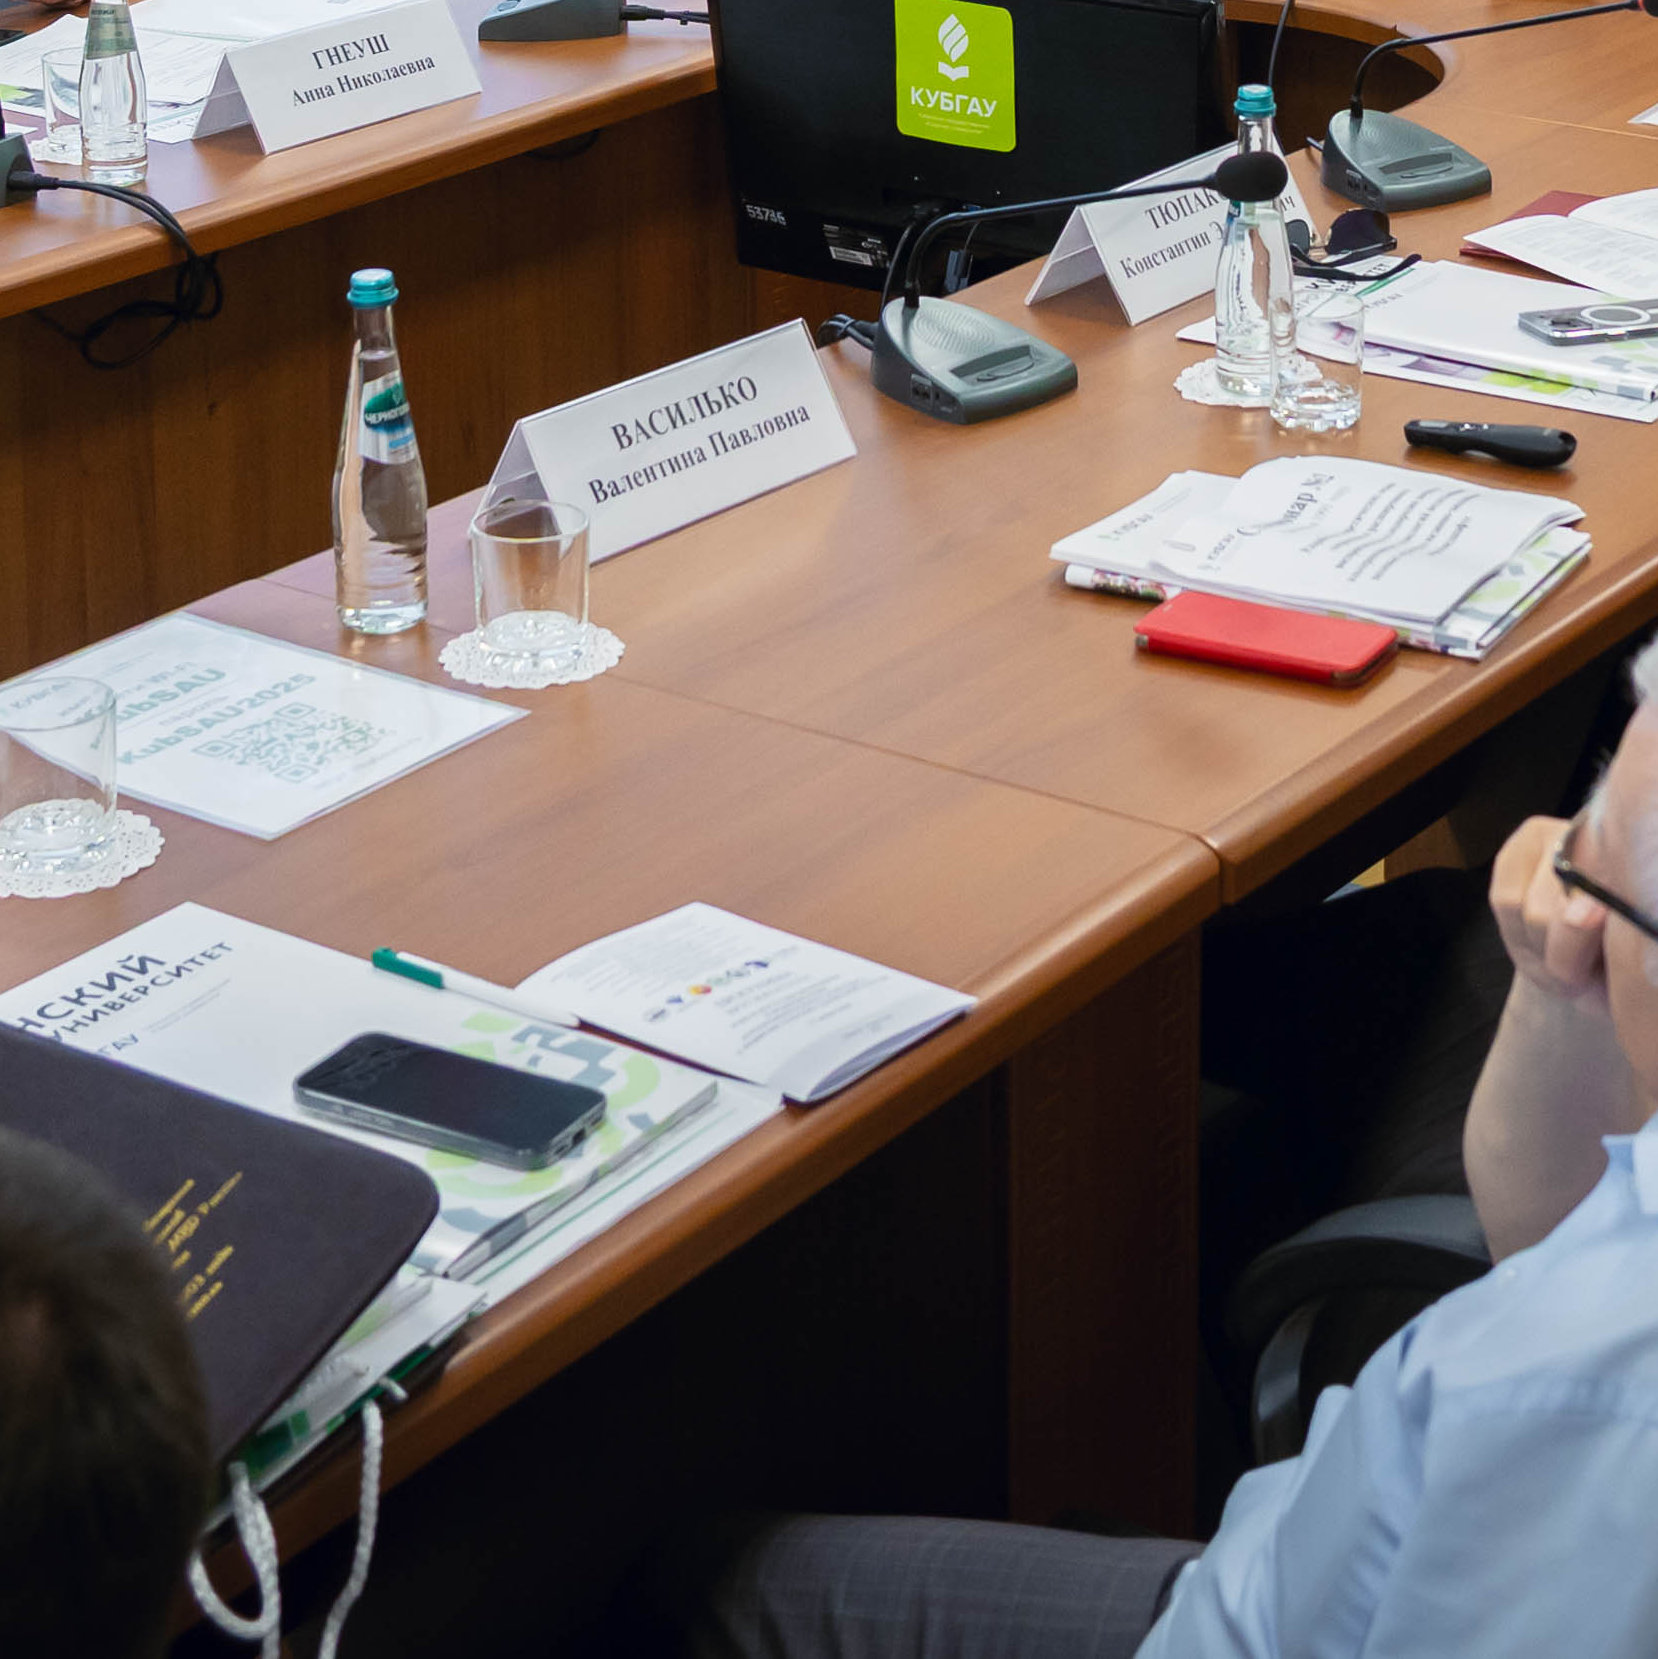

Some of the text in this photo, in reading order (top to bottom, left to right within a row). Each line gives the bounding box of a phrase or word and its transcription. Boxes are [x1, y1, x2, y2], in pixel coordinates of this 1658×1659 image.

[312, 33, 391, 71] ГНЕУШ
[292, 55, 436, 107] Анна Николаевна
[910, 85, 998, 118] КУБГАУ
[1144, 188, 1225, 230] ТЮПАК
[1119, 230, 1212, 279] Константин
[610, 374, 758, 452] ВАСИЛЬКО
[587, 404, 811, 505] Валентина Павловна
[116, 667, 226, 723] ubSAU
[17, 954, 167, 1032] НСКИЙ
